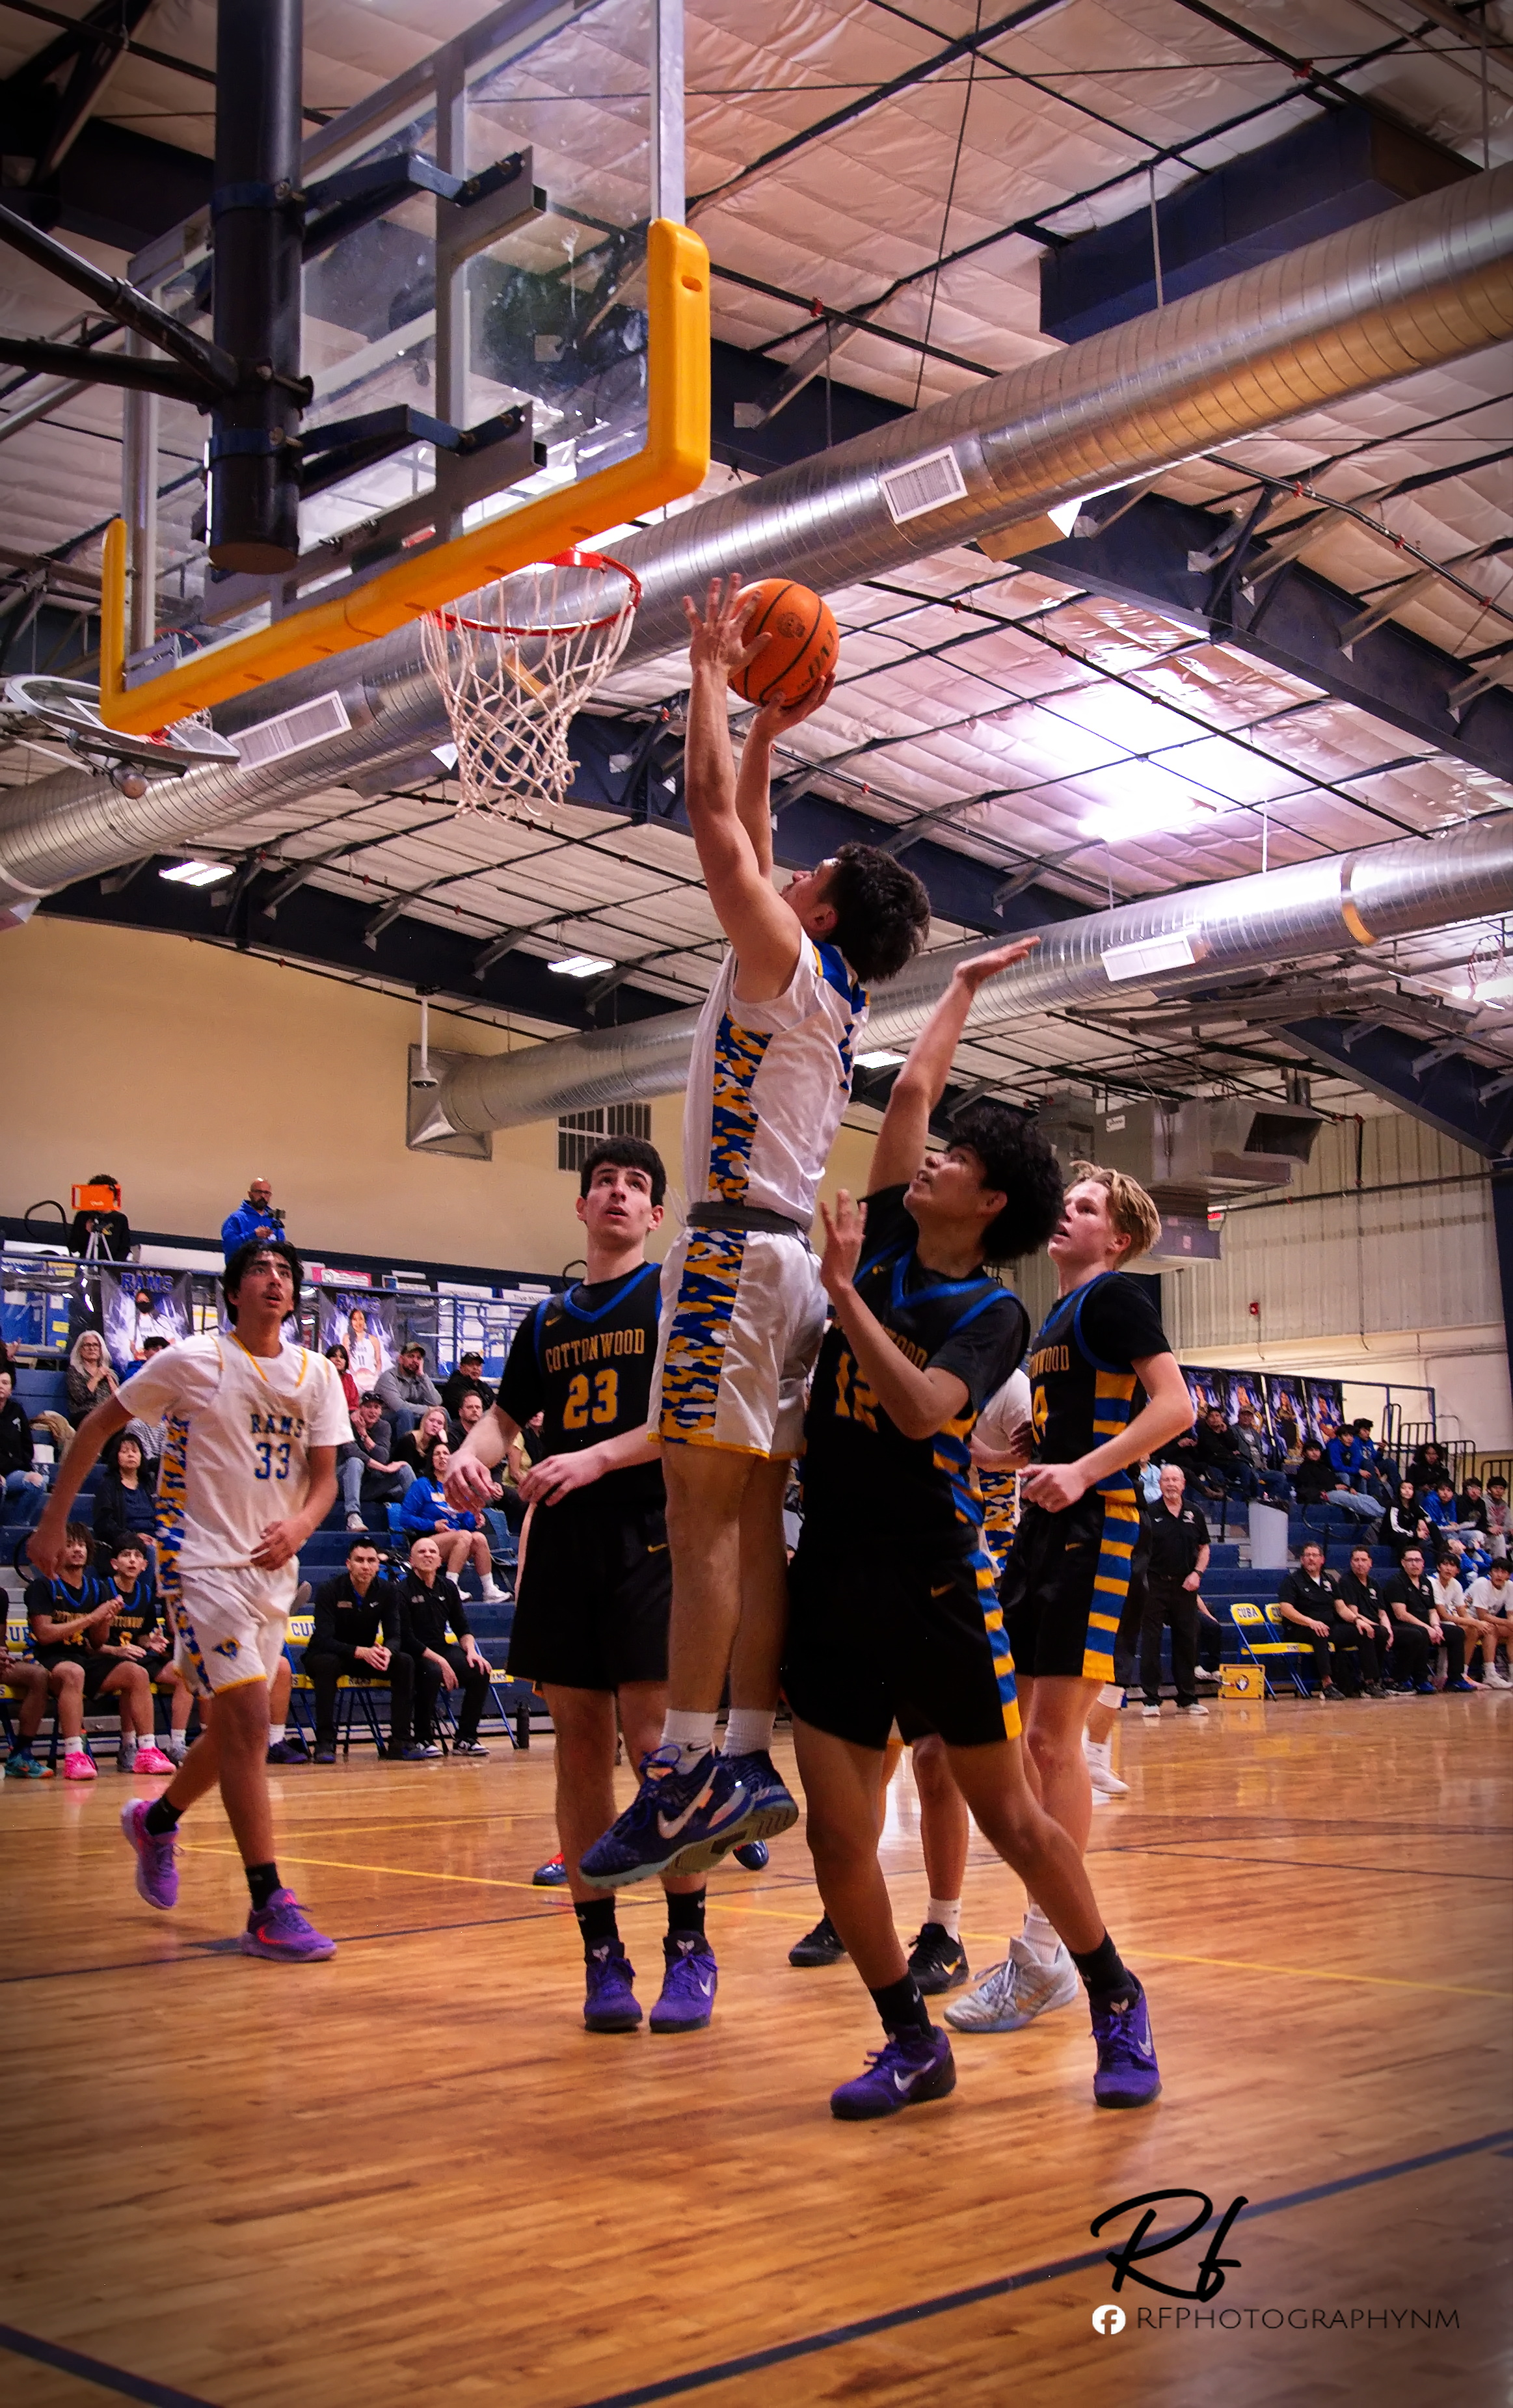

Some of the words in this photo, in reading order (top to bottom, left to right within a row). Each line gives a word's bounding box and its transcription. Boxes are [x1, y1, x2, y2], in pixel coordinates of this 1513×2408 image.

[120, 1270, 174, 1293] RAMS
[545, 1328, 645, 1374] COTTONWOOD
[563, 1367, 619, 1430] 23
[250, 1413, 305, 1438] RAMS
[1031, 1385, 1049, 1446] 4
[254, 1441, 291, 1480] 33
[1237, 1606, 1259, 1618] CUBA
[1271, 1607, 1281, 1618] CU
[291, 1622, 315, 1637] CU
